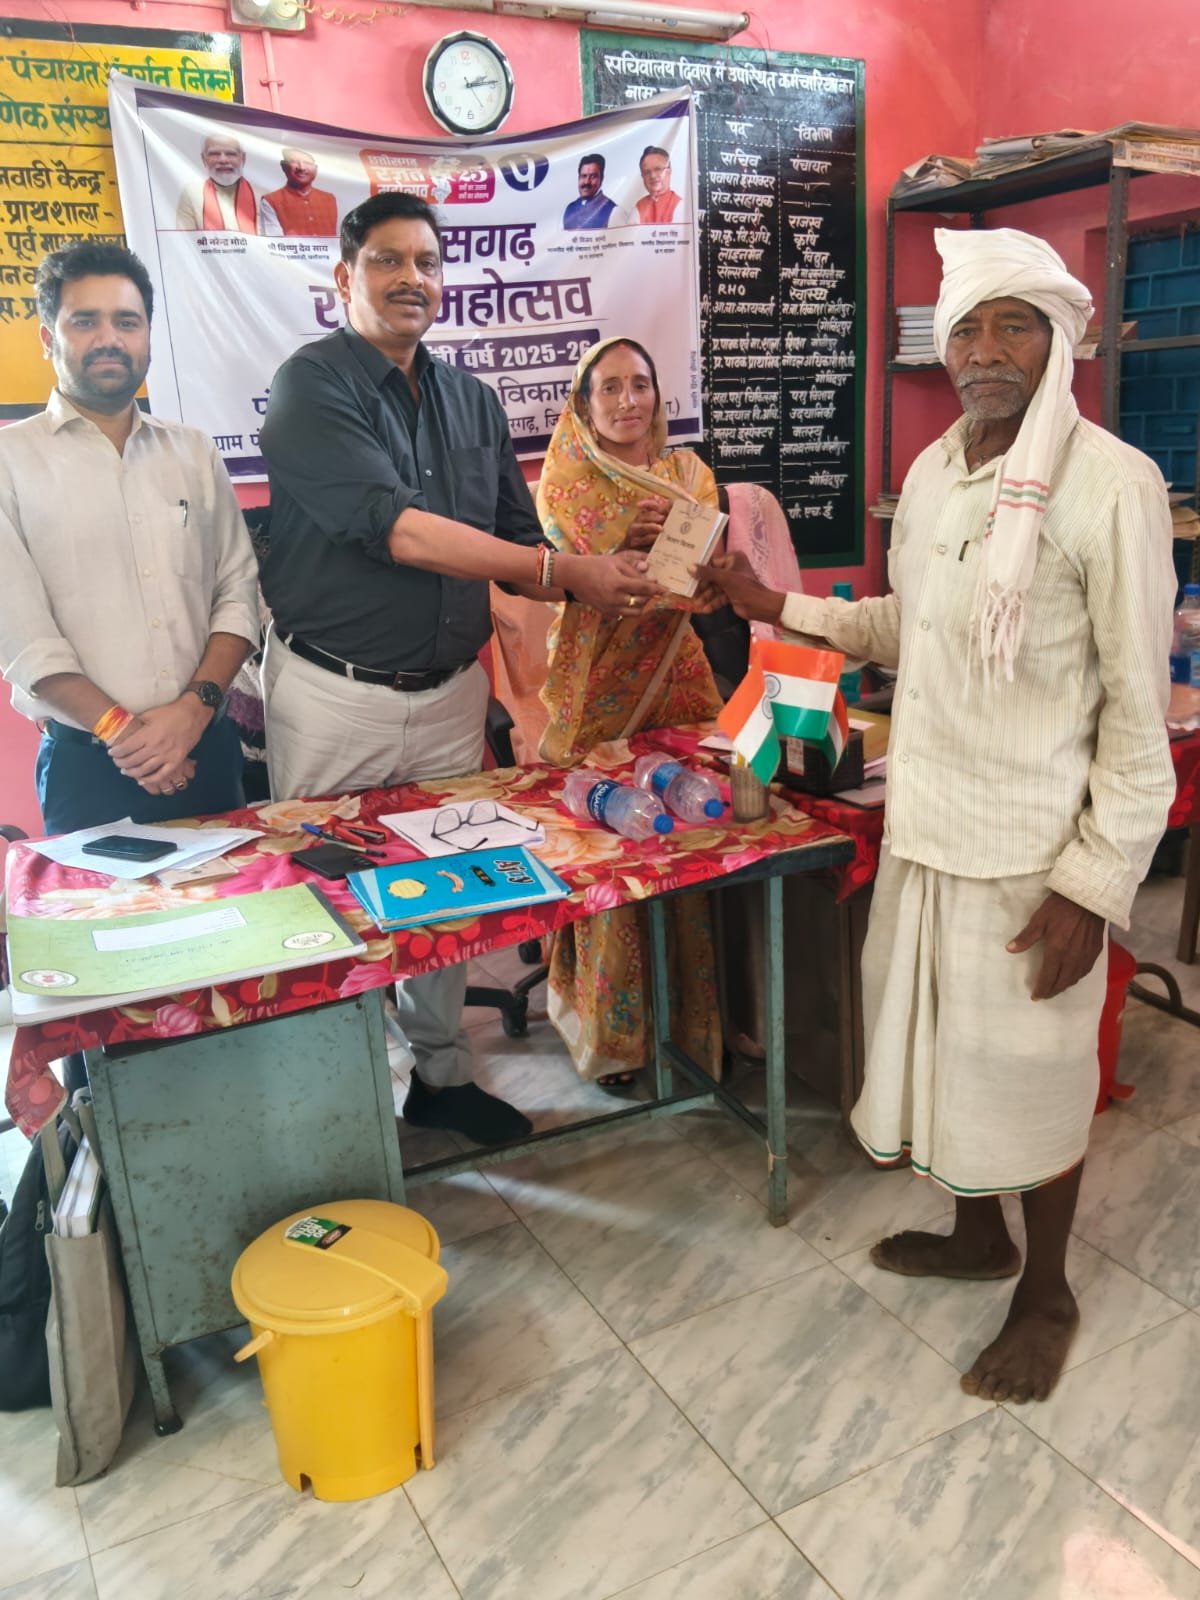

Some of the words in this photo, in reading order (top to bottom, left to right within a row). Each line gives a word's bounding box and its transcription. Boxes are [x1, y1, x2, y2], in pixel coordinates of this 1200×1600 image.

[8, 51, 98, 88] पंचायत
[178, 55, 231, 92] निम्न
[604, 50, 676, 80] सचिवालय
[677, 56, 712, 86] दिवस
[711, 60, 727, 81] में
[727, 62, 778, 96] उपस्थित
[793, 123, 834, 142] विभाग
[720, 148, 762, 168] सचिव
[790, 154, 832, 174] पंचायत
[719, 207, 765, 227] पटवारी
[788, 215, 824, 230] राजस्व
[793, 229, 820, 250] कृषि
[434, 267, 593, 328] महोत्सव
[462, 342, 496, 369] वर्ष
